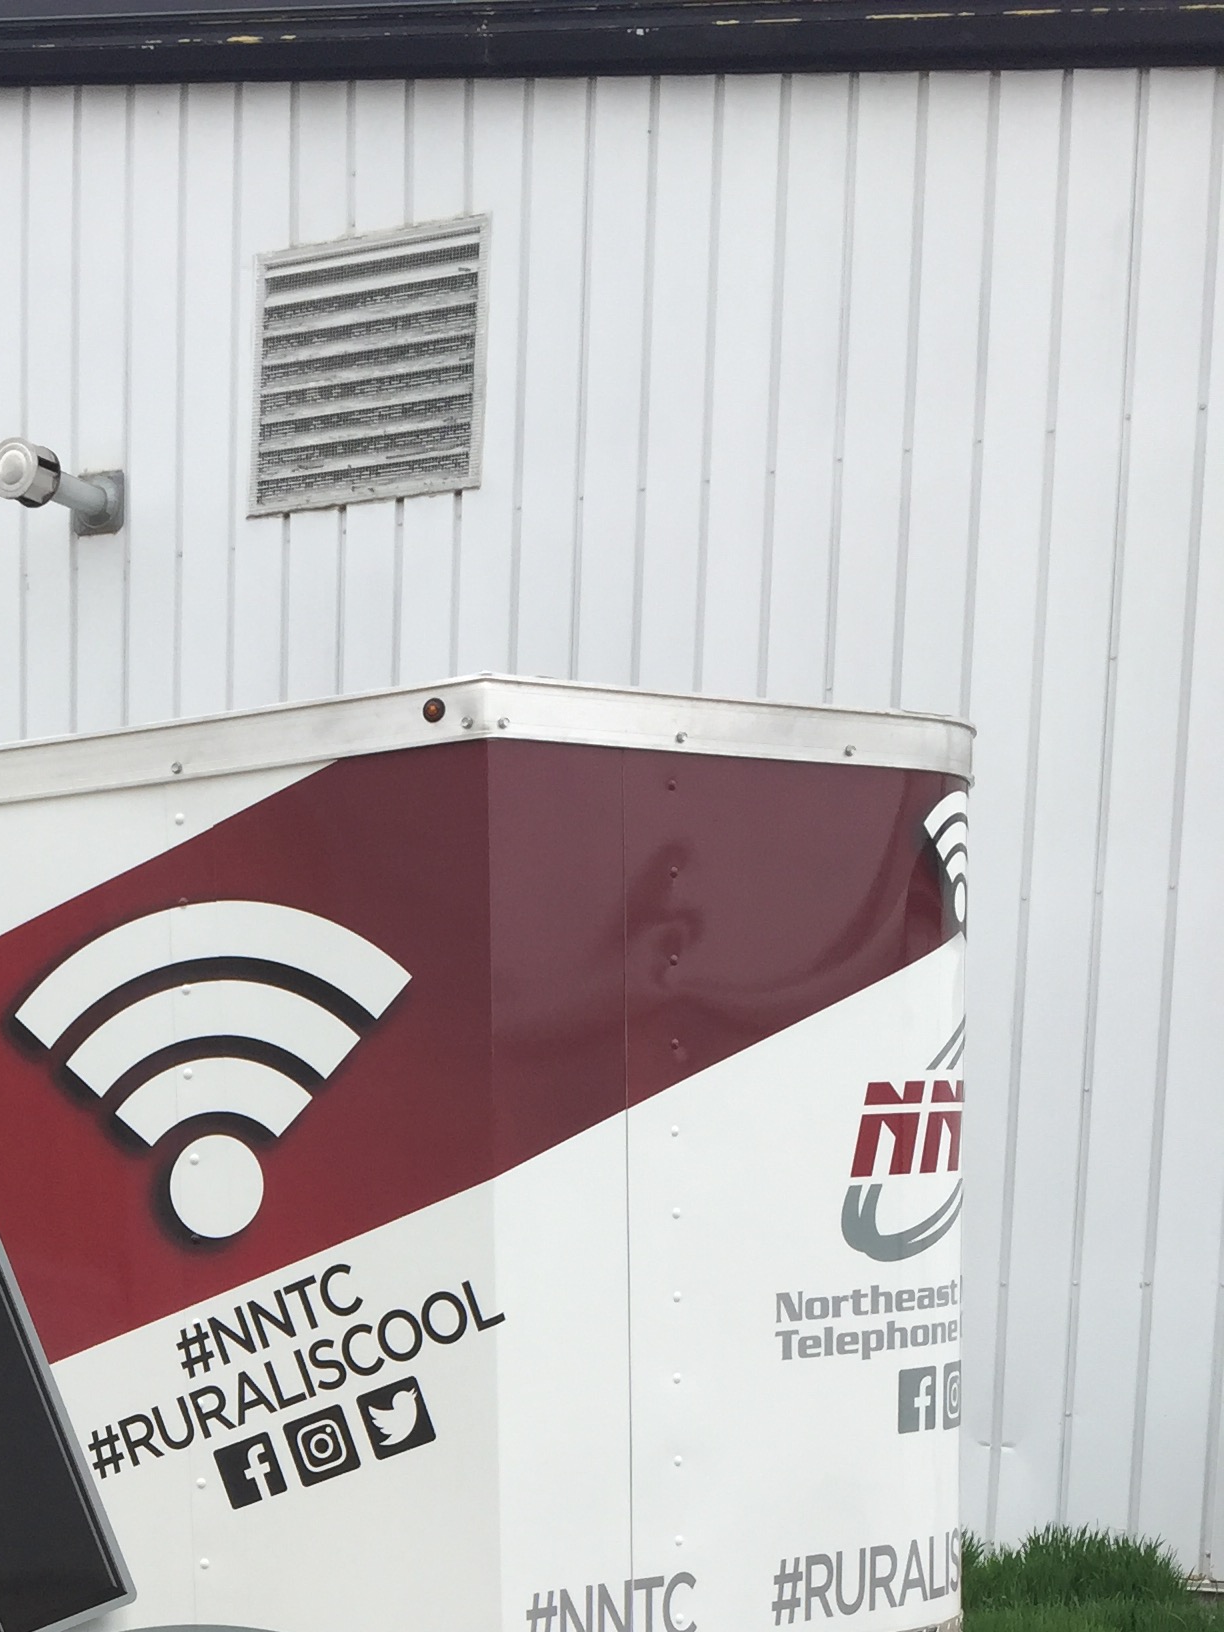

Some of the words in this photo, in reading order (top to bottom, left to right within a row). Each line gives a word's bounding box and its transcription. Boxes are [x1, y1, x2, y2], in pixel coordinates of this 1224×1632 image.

[176, 1263, 364, 1379] #NNTC
[775, 1279, 958, 1323] Northeast
[775, 1317, 958, 1360] Telephone
[87, 1280, 506, 1479] #RURALISCOOL
[771, 1527, 959, 1626] #RURALIS
